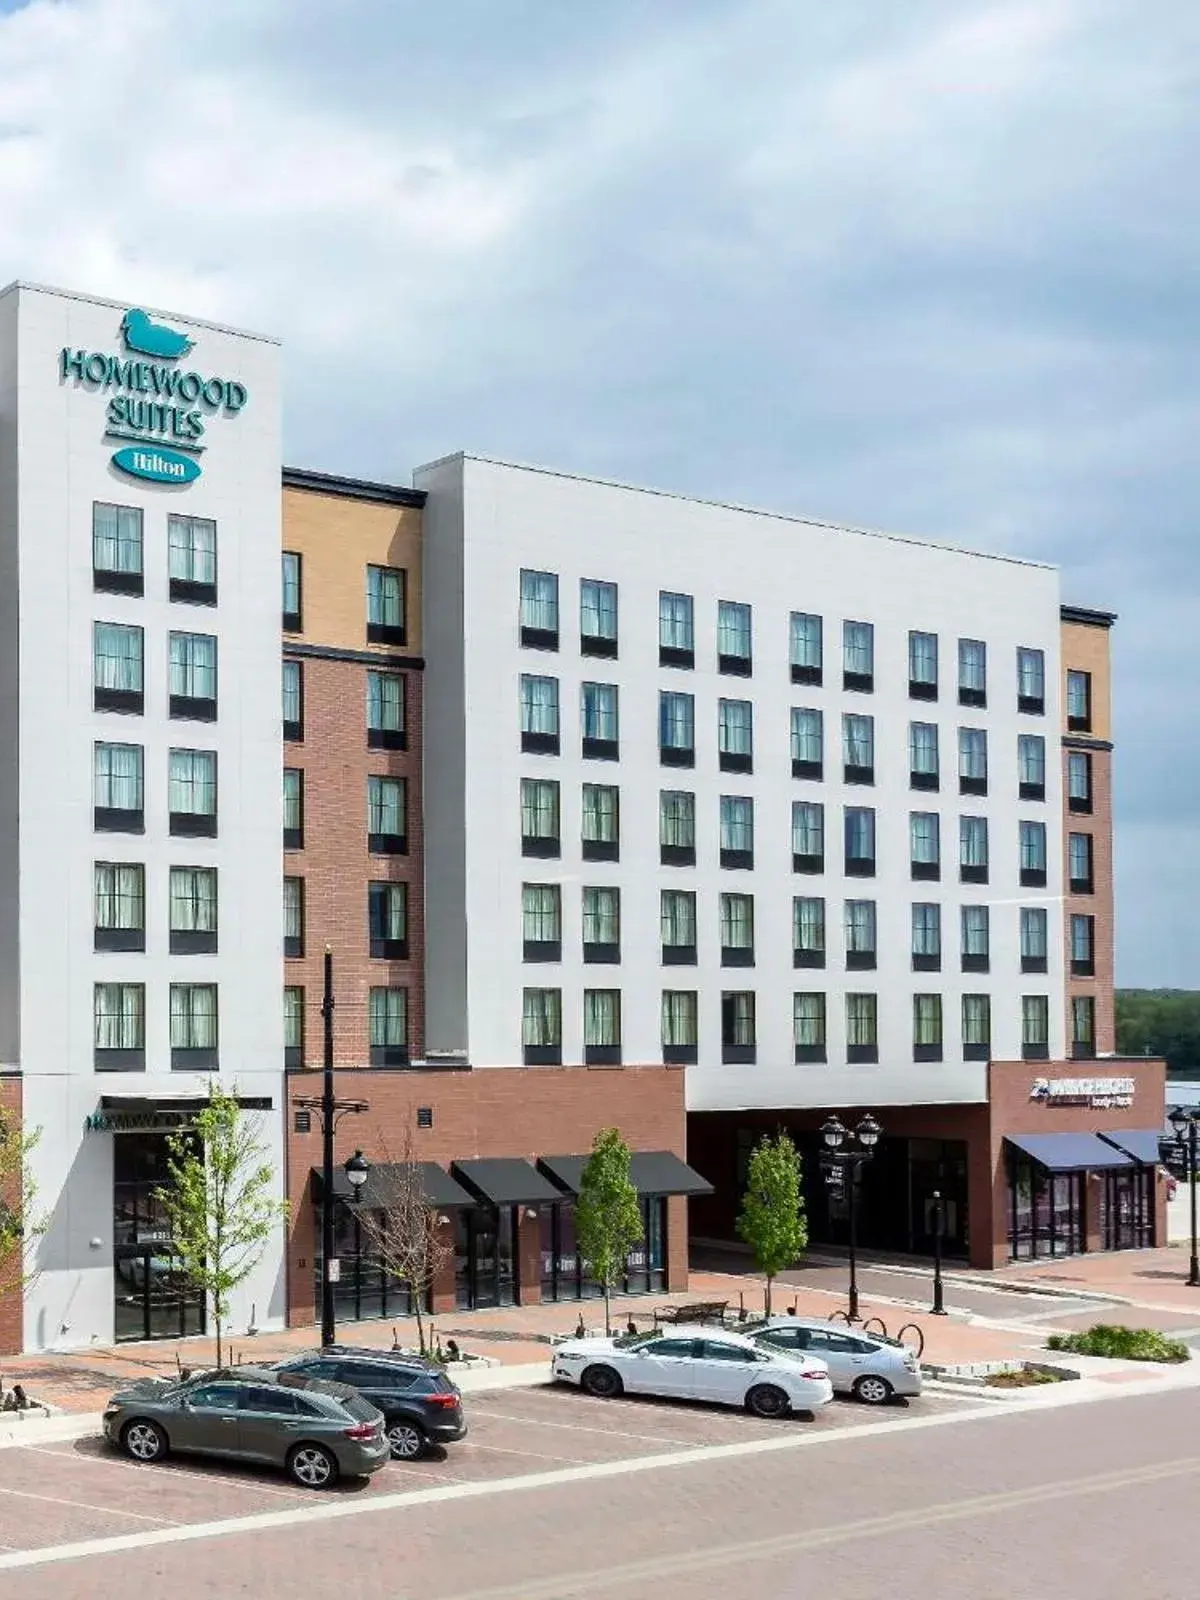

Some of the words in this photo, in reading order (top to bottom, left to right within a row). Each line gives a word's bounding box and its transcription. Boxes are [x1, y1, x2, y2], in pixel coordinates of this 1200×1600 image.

[62, 347, 247, 410] HOMEWOOD
[107, 396, 206, 438] SUITES
[133, 451, 185, 477] Hilton
